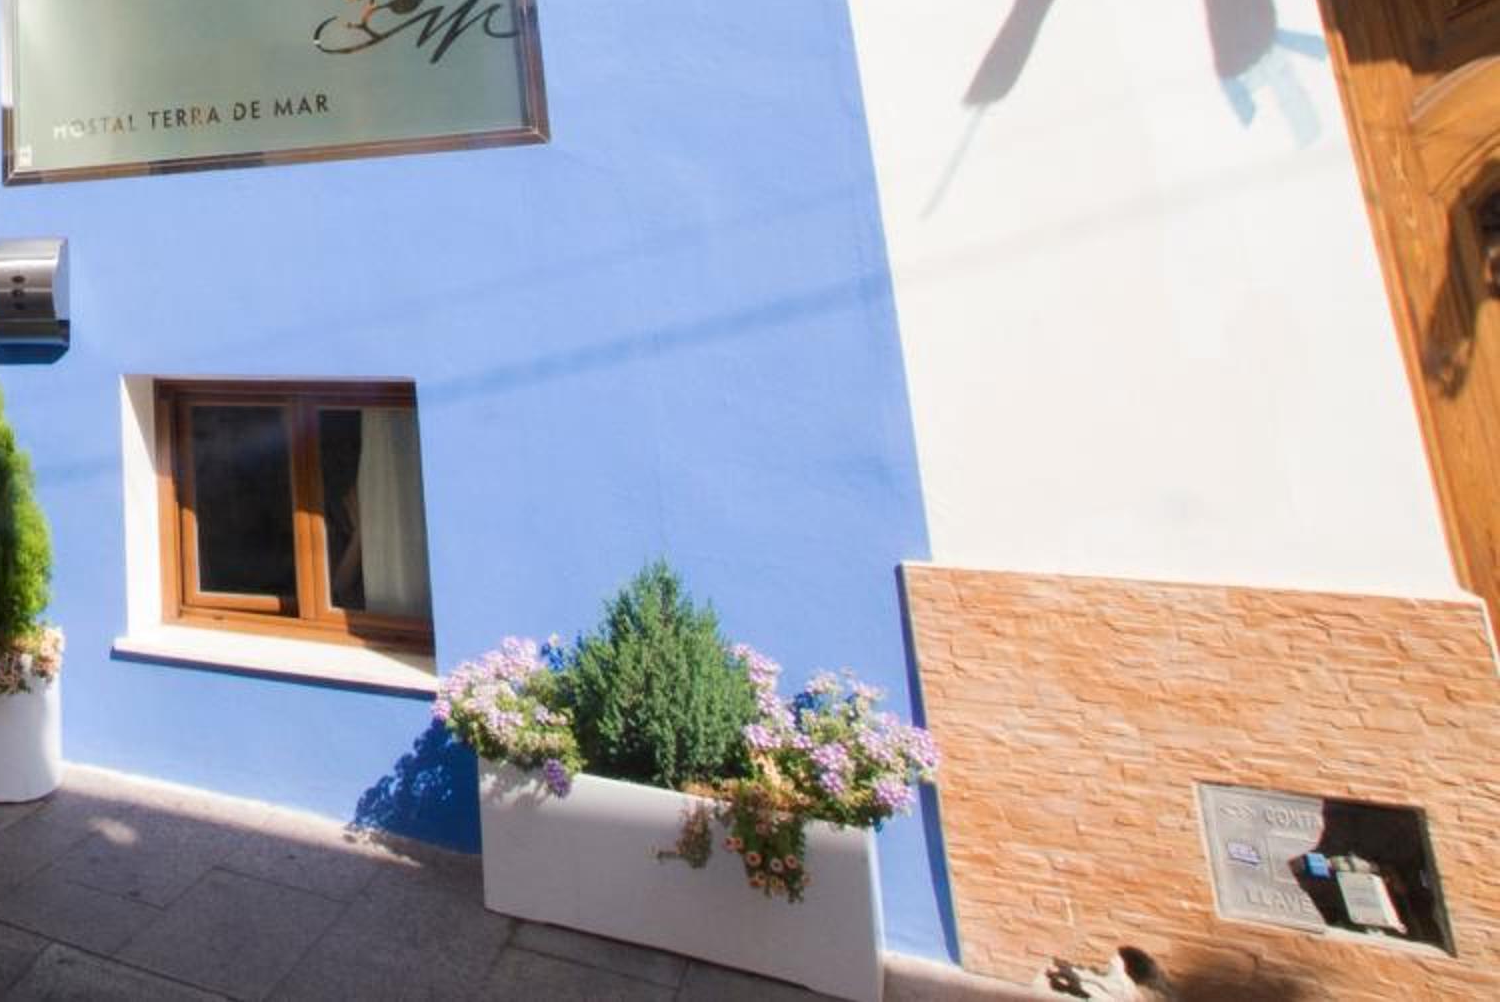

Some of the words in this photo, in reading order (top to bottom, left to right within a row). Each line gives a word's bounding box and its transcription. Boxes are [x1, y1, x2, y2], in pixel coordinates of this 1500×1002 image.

[52, 114, 138, 140] HOSTAL
[148, 105, 221, 129] TERRA
[232, 100, 261, 121] DE
[273, 93, 330, 117] MAR
